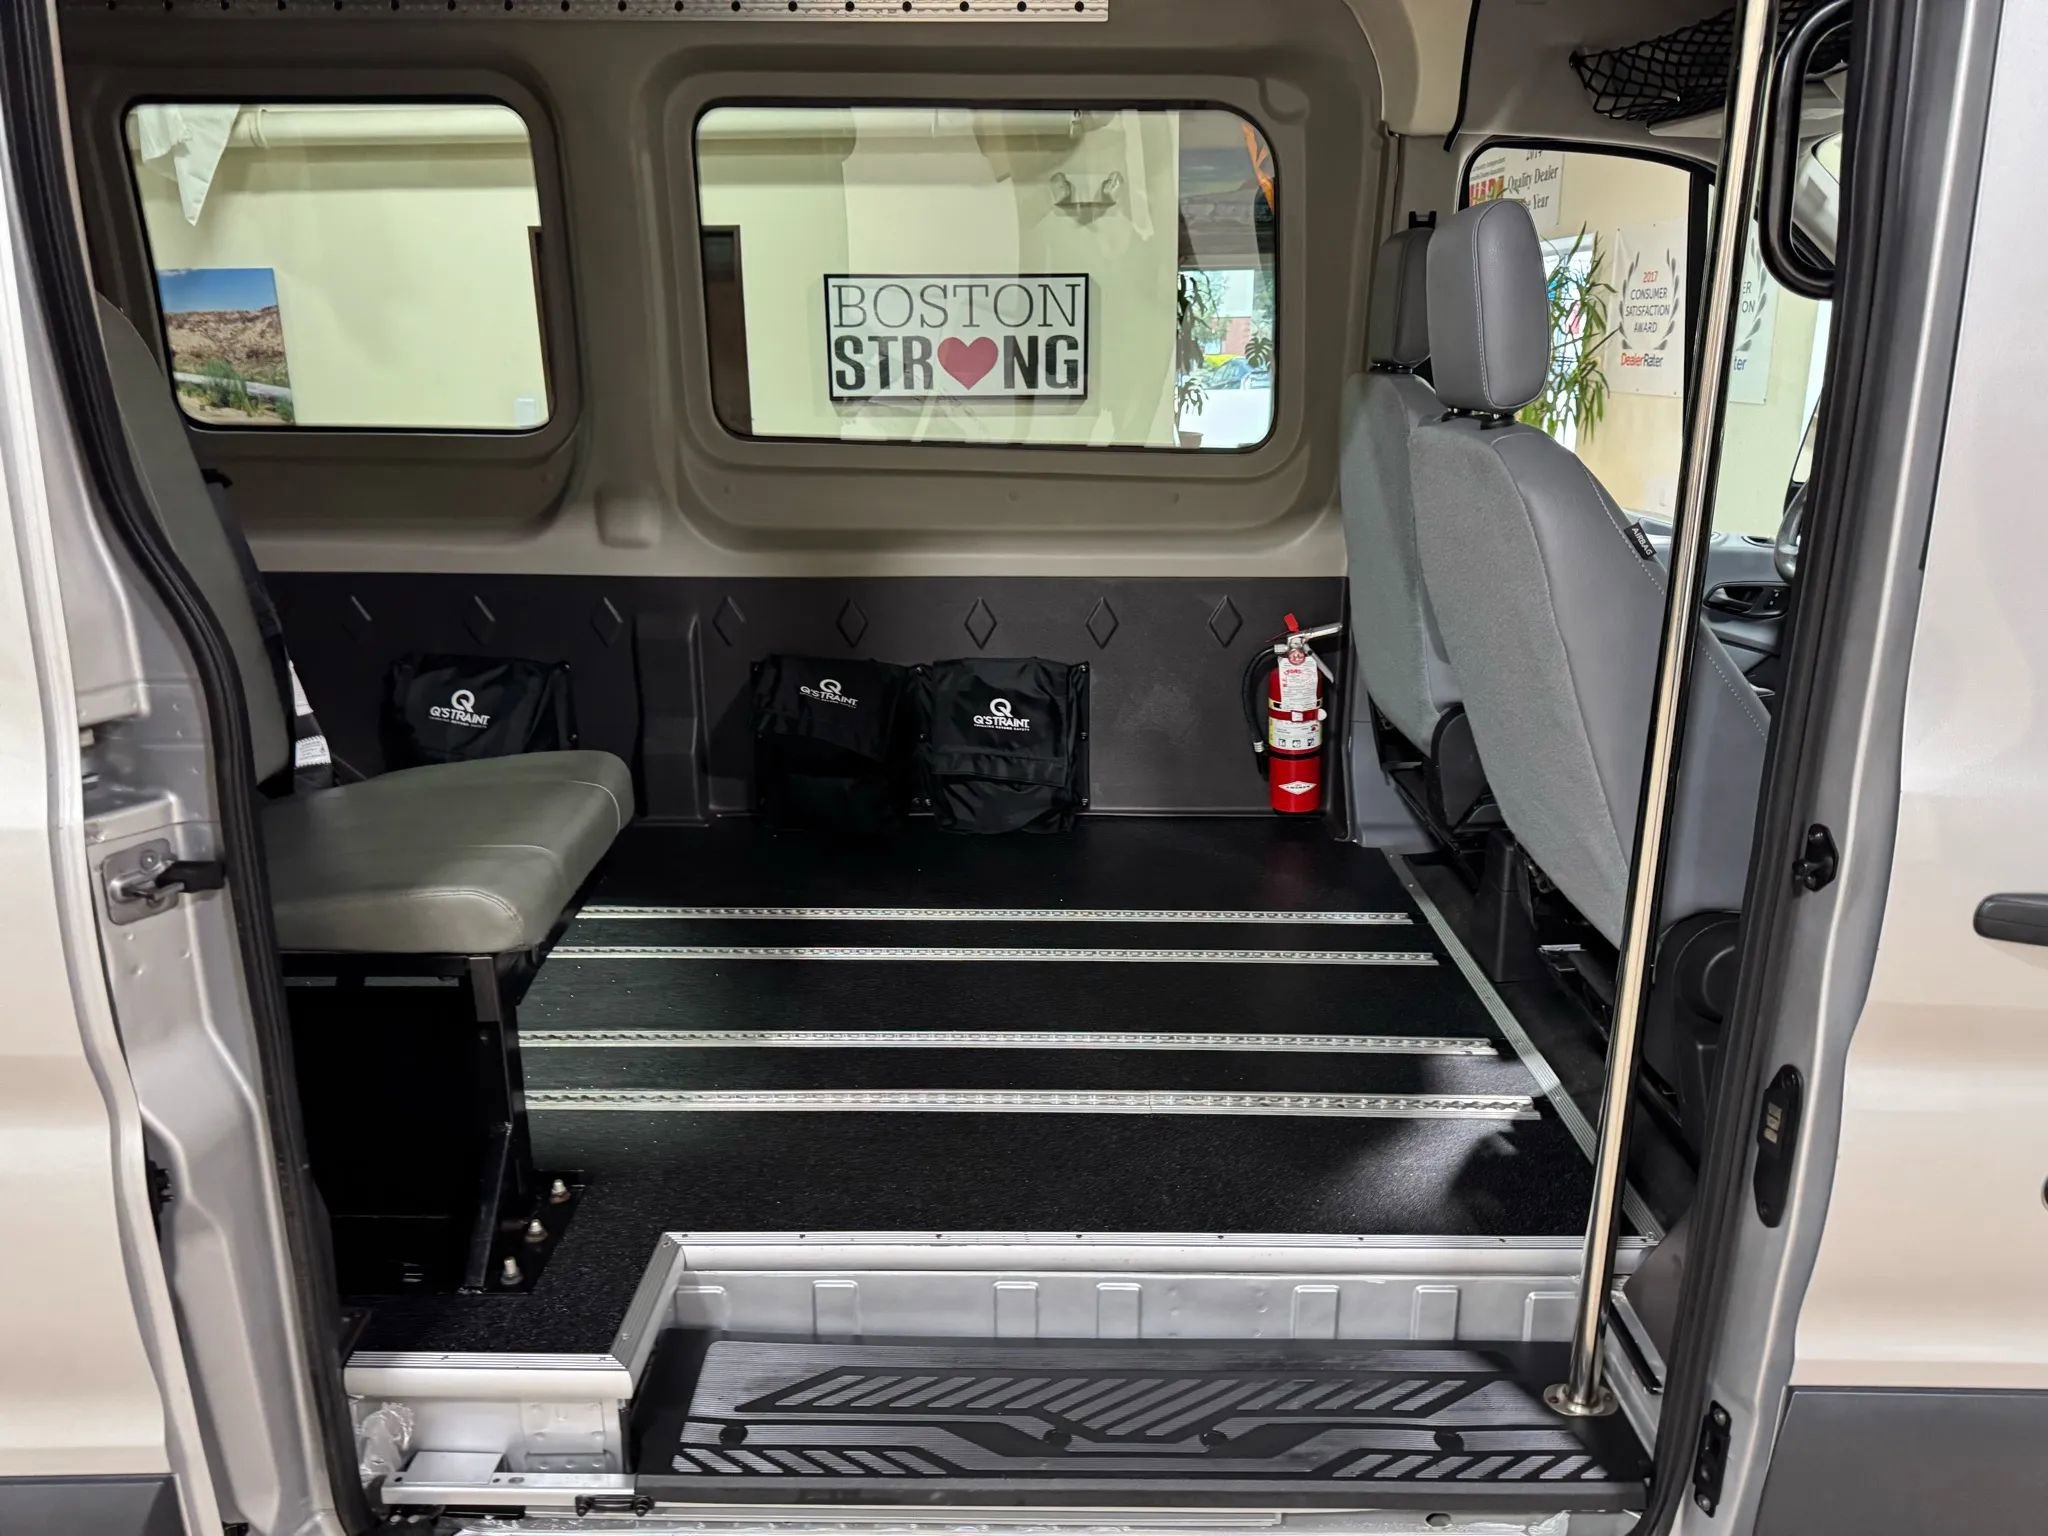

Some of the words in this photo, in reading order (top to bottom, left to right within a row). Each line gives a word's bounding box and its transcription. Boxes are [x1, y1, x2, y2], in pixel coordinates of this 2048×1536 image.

[1507, 171, 1532, 191] Quality
[1534, 164, 1559, 184] Dealer
[1533, 194, 1549, 209] Year
[1642, 271, 1658, 283] 2017
[1630, 287, 1668, 300] CONSUMER
[832, 284, 1081, 328] BOSTON
[1625, 304, 1671, 316] SATISFACTION
[1634, 322, 1658, 333] AWARD
[834, 335, 1079, 391] STRNG
[1621, 352, 1663, 367] DealerRater
[1631, 527, 1654, 556] AIRBAG
[451, 689, 475, 713] Q
[990, 698, 1014, 718] Q
[430, 705, 491, 725] Q'STRAINT
[973, 714, 1030, 728] Q'STRAINT
